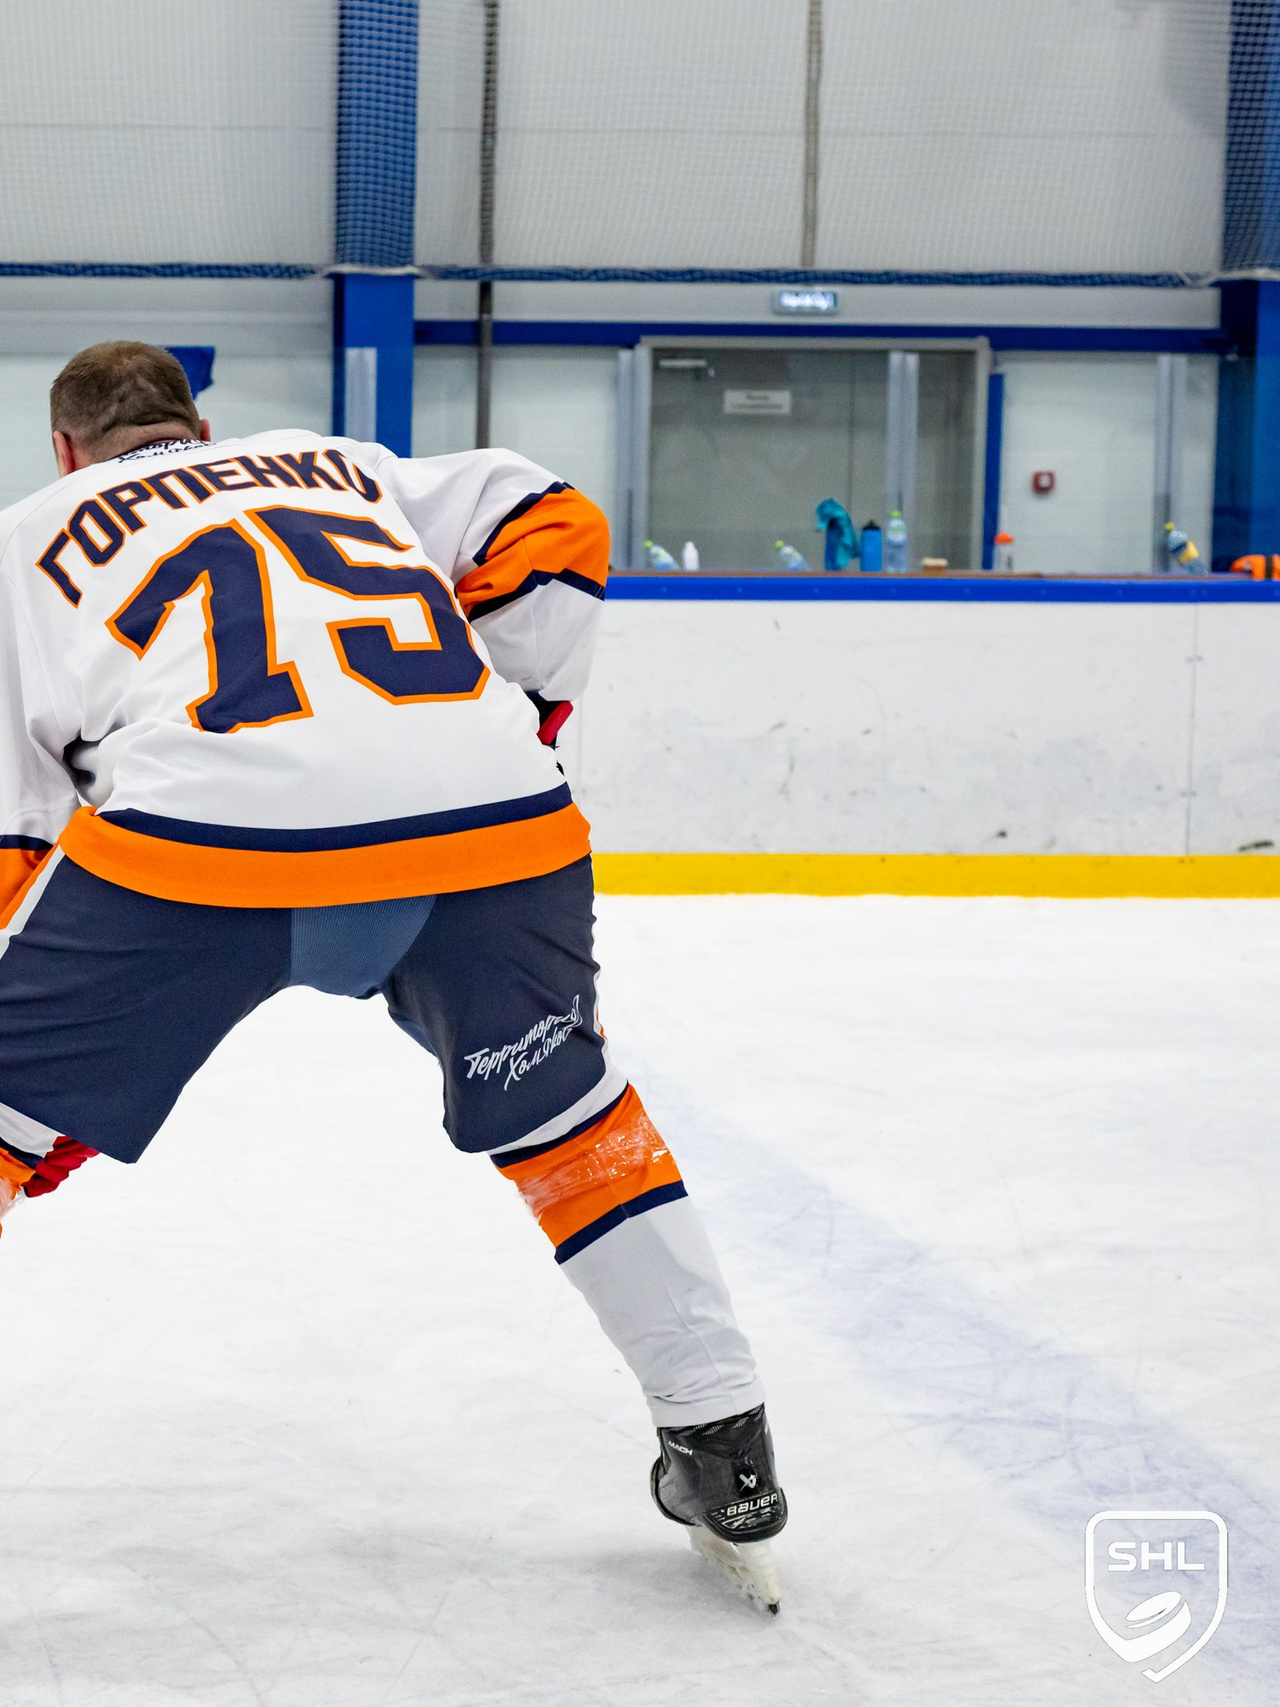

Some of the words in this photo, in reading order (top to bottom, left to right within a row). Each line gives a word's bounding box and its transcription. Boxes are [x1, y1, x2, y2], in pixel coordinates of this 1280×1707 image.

[35, 449, 383, 609] ГОРПЕНКО
[104, 504, 491, 734] 75
[668, 1440, 694, 1456] MACH
